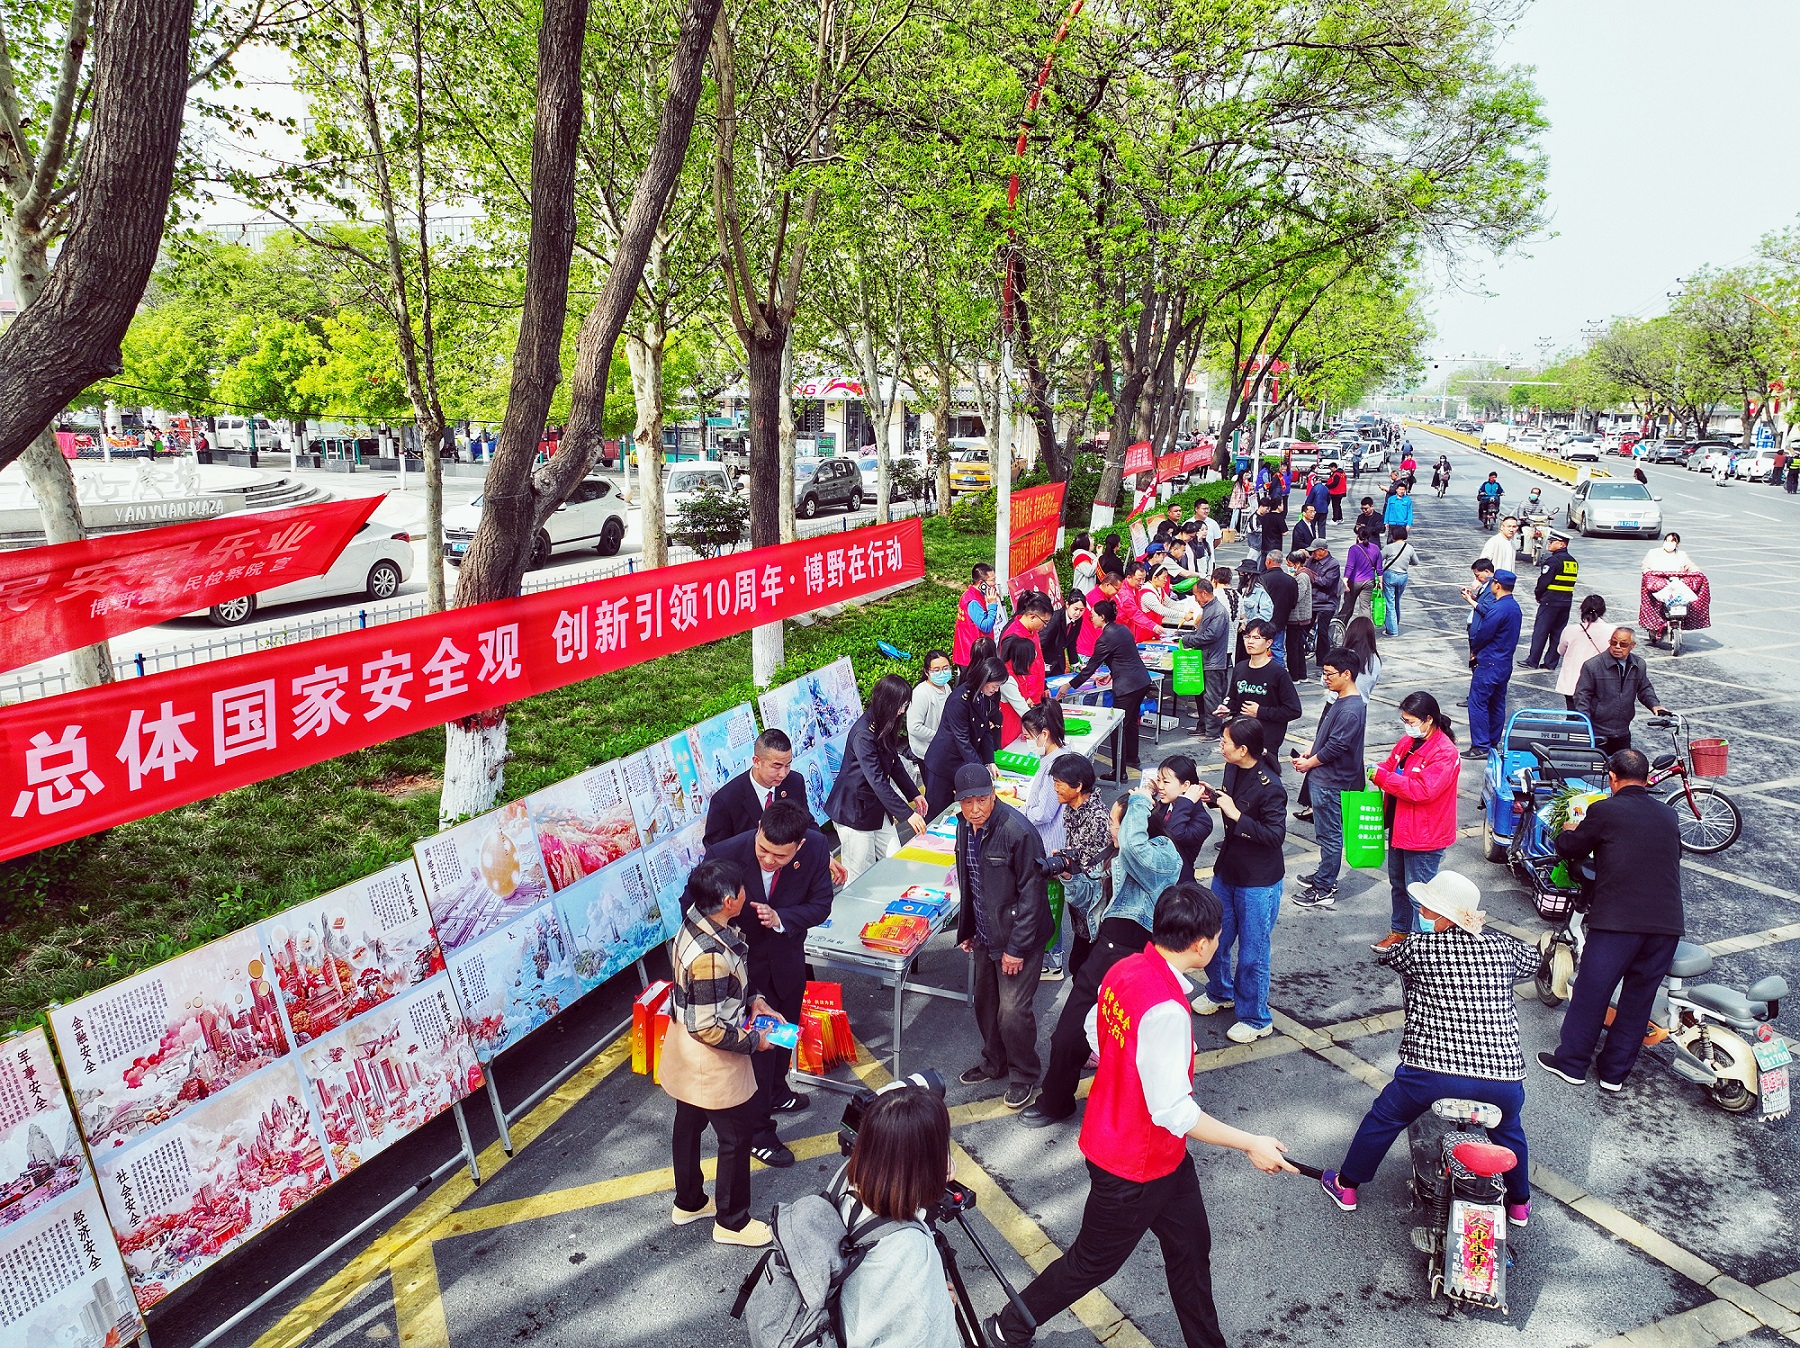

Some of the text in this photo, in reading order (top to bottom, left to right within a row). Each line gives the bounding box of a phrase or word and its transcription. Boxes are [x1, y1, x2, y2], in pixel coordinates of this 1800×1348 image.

[114, 499, 225, 523] YAN YUAN PLAZA
[10, 534, 903, 818] 总体国家安全观 创新引领10周年·博野在行动
[1236, 680, 1268, 695] Gucci
[401, 873, 419, 918] 文化安全
[436, 989, 456, 1035] 科技安全
[71, 1015, 97, 1075] 金融安全
[17, 1048, 48, 1113] 军事安全
[115, 1168, 142, 1228] 社会安全
[72, 1208, 102, 1272] 经济安全
